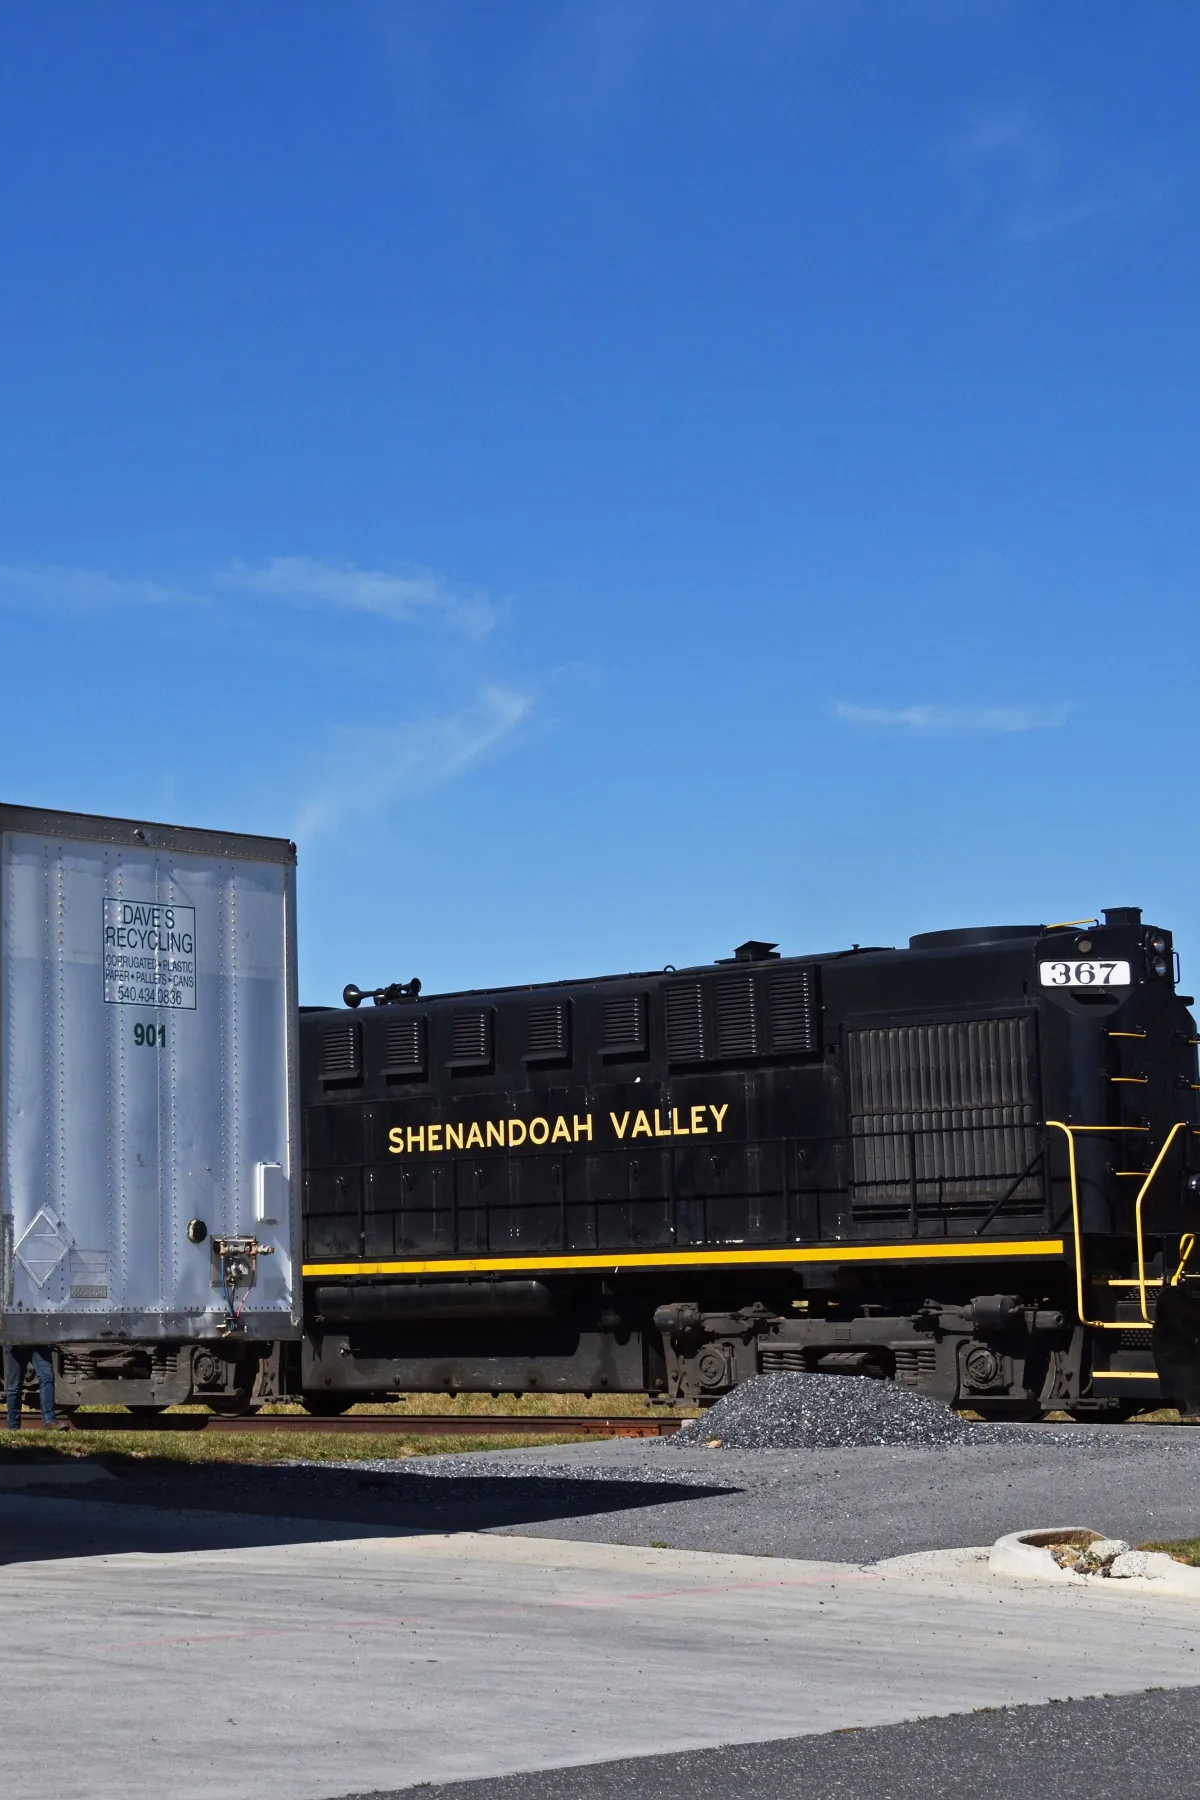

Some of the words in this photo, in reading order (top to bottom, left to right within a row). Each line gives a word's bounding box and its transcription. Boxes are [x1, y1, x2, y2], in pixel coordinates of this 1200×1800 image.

[123, 904, 176, 929] DAVE'S
[106, 925, 193, 954] RECYCLING
[106, 954, 157, 970] CORRUGATED
[162, 959, 194, 974] PLASTIC
[1050, 962, 1118, 985] 367
[105, 968, 130, 982] PAPER
[135, 971, 168, 986] PALLETS
[172, 974, 194, 988] CANS
[117, 985, 182, 1006] 540.434.0836
[133, 1022, 166, 1048] 901
[387, 1113, 593, 1154] SHENANDOAH
[609, 1103, 729, 1139] VALLEY
